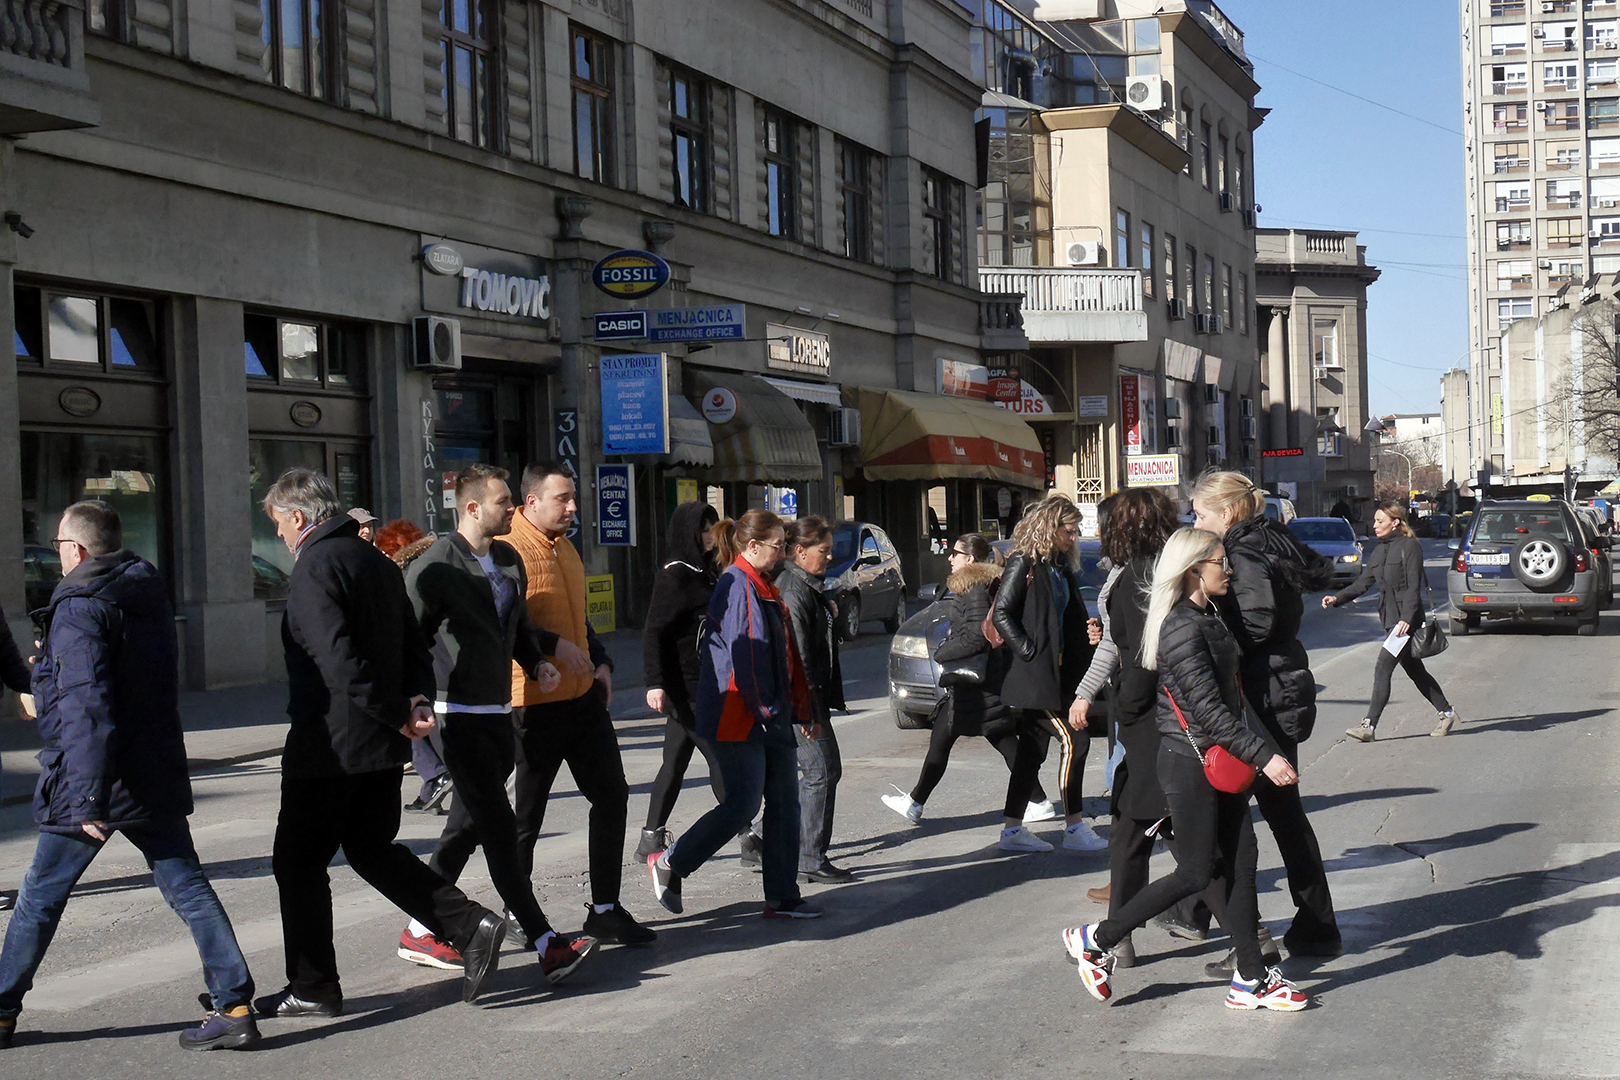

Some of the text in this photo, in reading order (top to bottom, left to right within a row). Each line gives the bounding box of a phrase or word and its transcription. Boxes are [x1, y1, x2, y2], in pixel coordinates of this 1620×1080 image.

[433, 252, 459, 266] ZLATARA
[601, 268, 657, 283] FOSSIL
[598, 320, 641, 331] CASIO
[658, 327, 734, 339] EXCHANGE OFFICE
[792, 336, 830, 367] LORENC
[603, 357, 658, 370] STAN PROMET
[603, 369, 657, 379] NEKRETNINE
[996, 381, 1018, 390] Image
[995, 388, 1017, 397] Center
[602, 490, 626, 499] CENTAR
[602, 520, 627, 528] EXCHANGE
[606, 530, 623, 538] OFFICE
